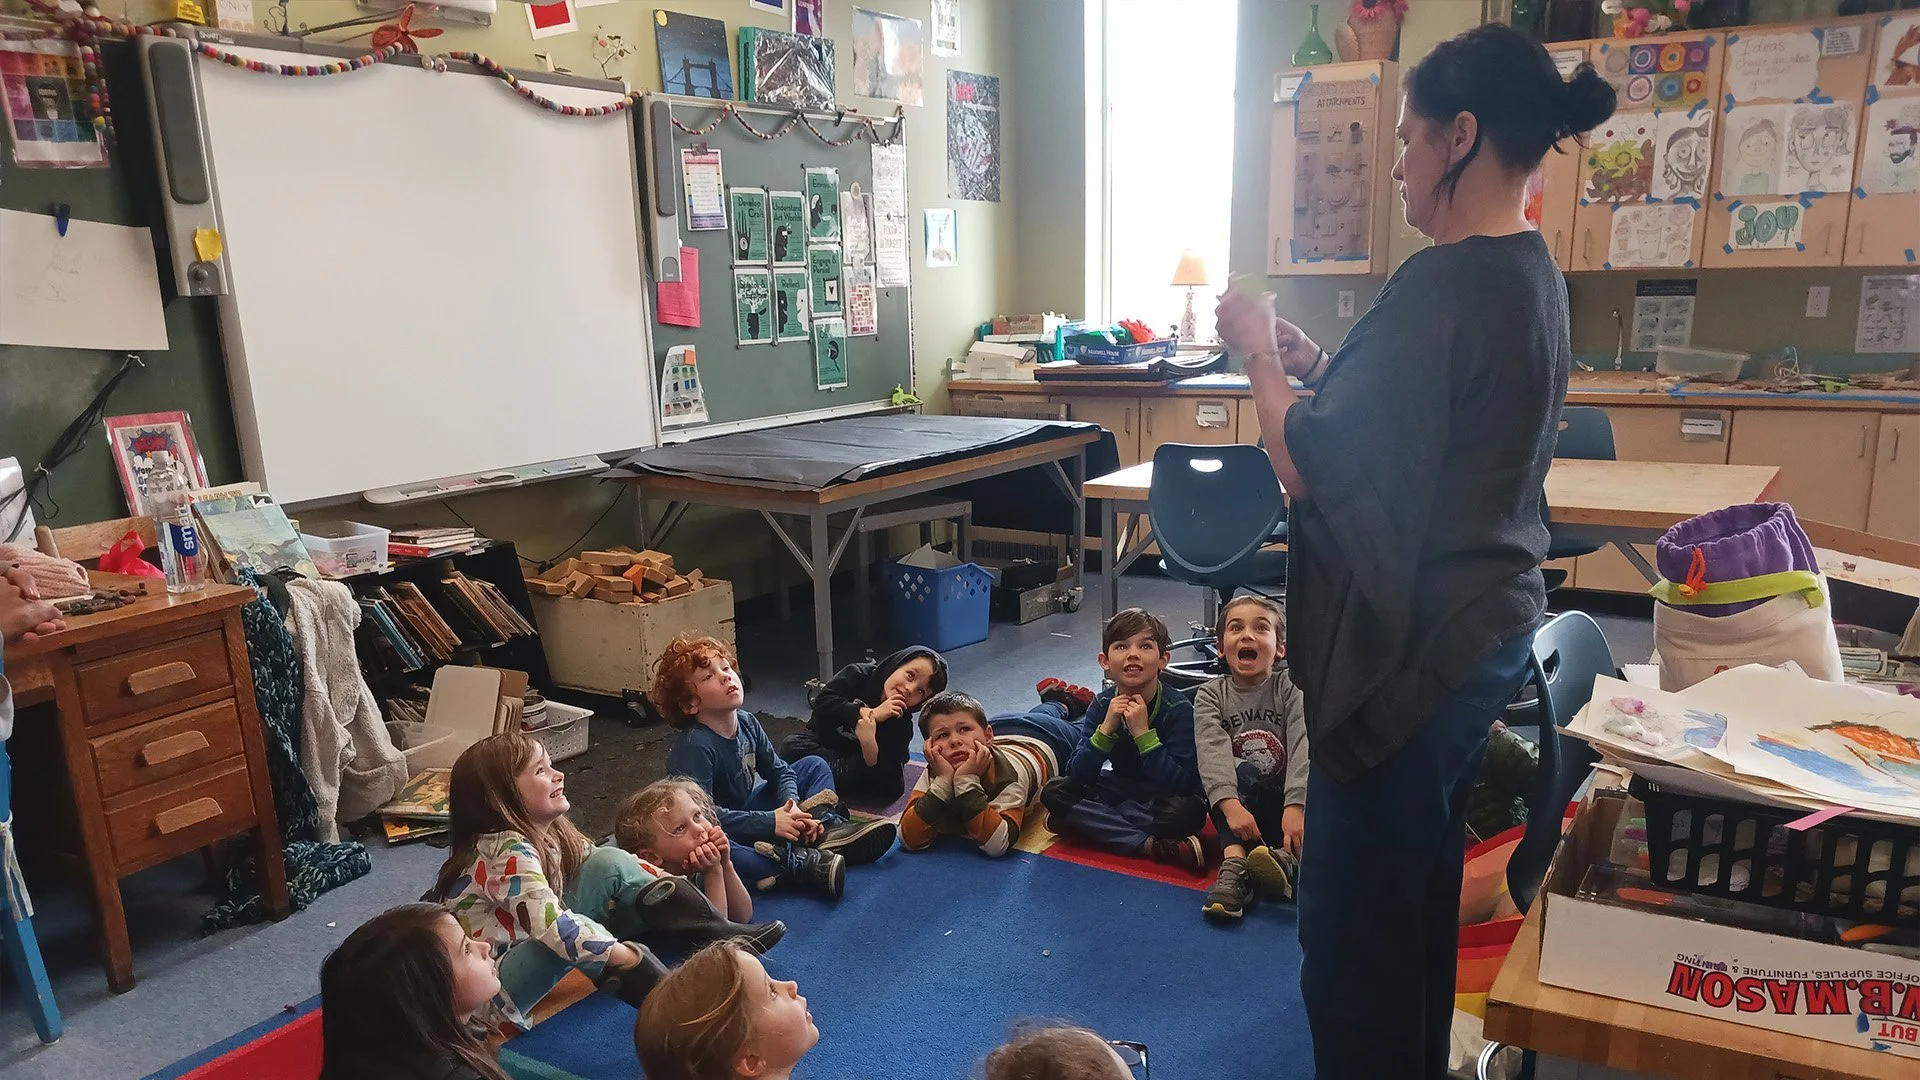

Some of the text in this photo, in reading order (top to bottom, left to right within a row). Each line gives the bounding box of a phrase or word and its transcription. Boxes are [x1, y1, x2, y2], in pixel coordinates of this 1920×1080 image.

[174, 503, 195, 551] smart
[1221, 708, 1283, 731] BEWARE
[1731, 965, 1739, 973] &
[1743, 967, 1808, 980] FURNITURE
[1811, 969, 1873, 980] SUPPLIES,
[1876, 970, 1920, 984] OFFICE
[1878, 1023, 1918, 1042] BUT
